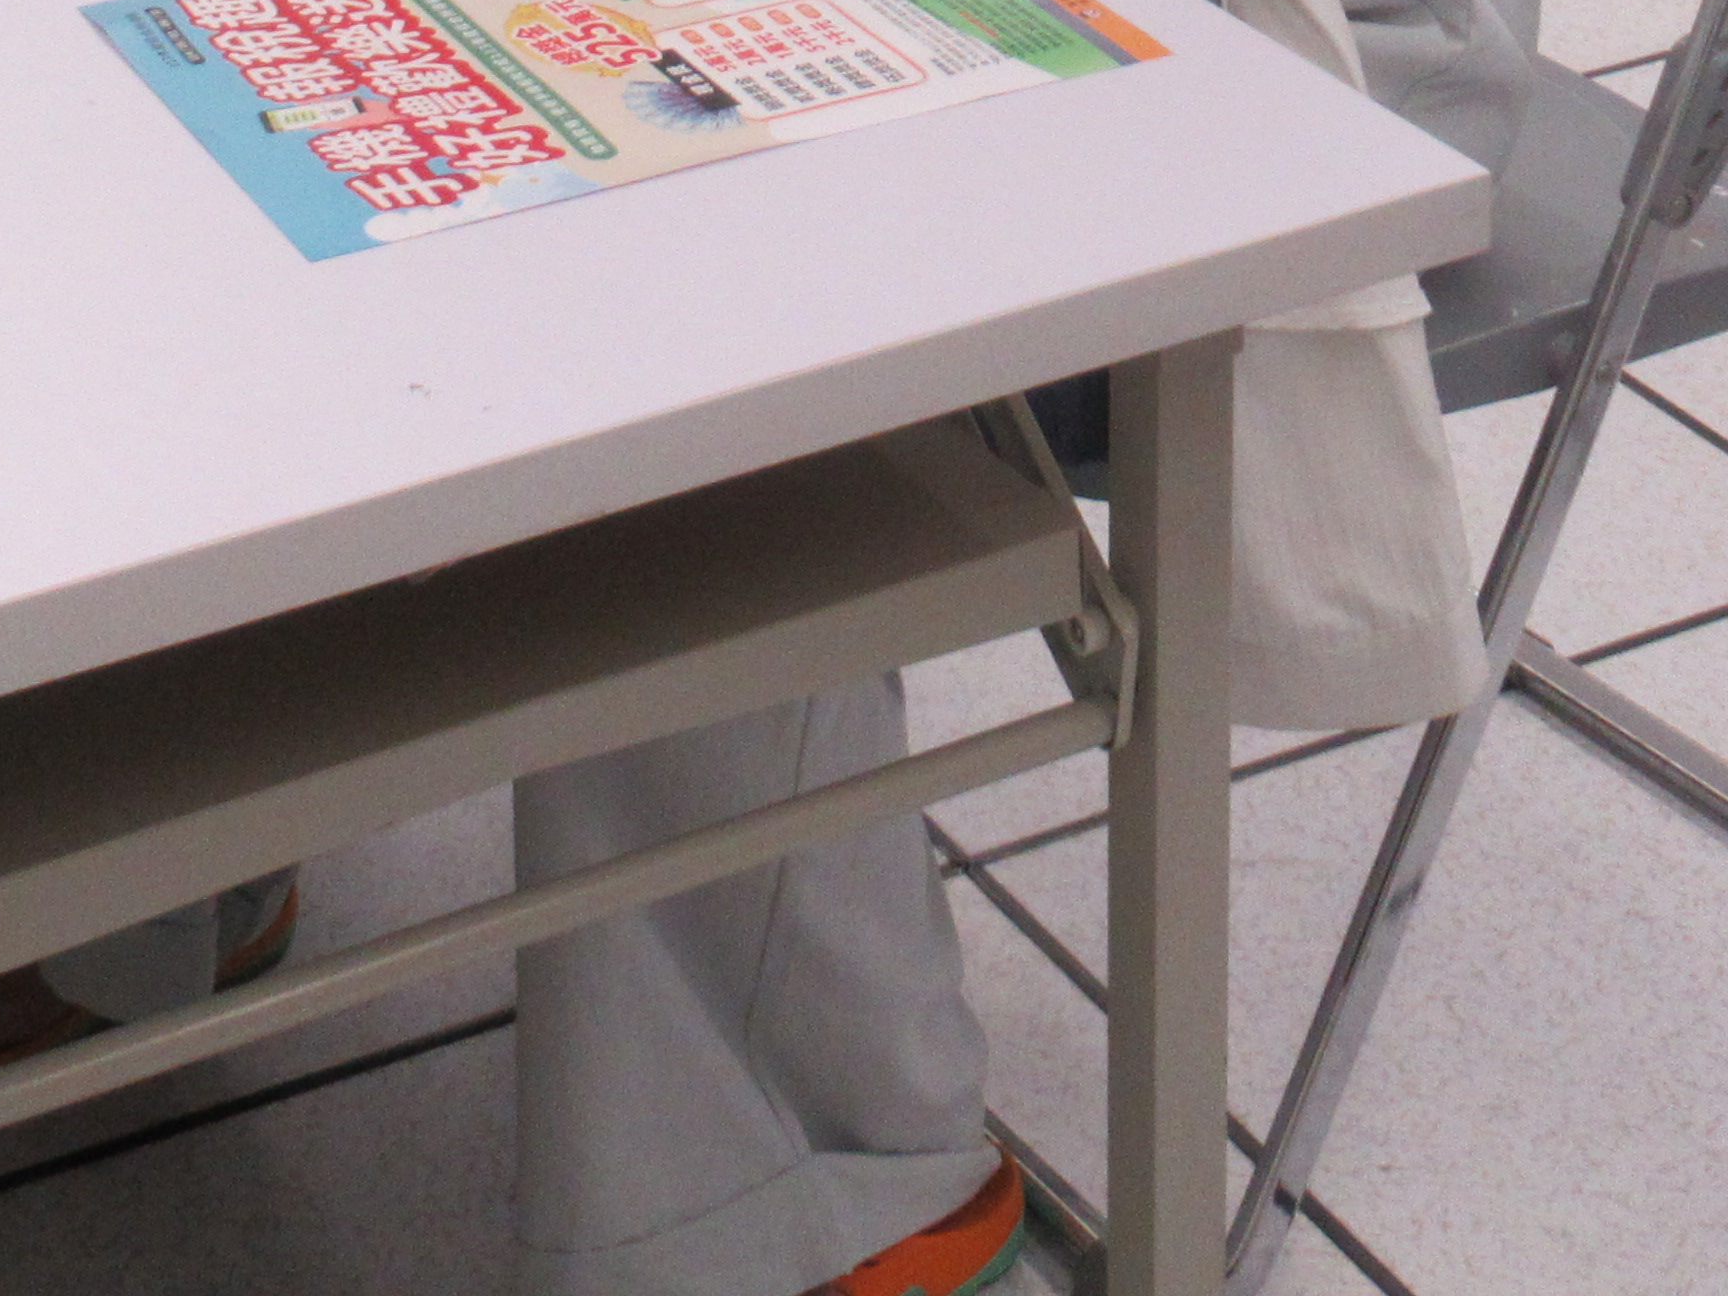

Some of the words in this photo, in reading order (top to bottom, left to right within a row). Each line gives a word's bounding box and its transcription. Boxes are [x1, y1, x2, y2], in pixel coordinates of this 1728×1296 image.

[516, 22, 590, 67] 總獎金
[692, 46, 740, 72] 5萬元
[722, 40, 767, 66] 2萬元
[310, 122, 476, 211] 手機
